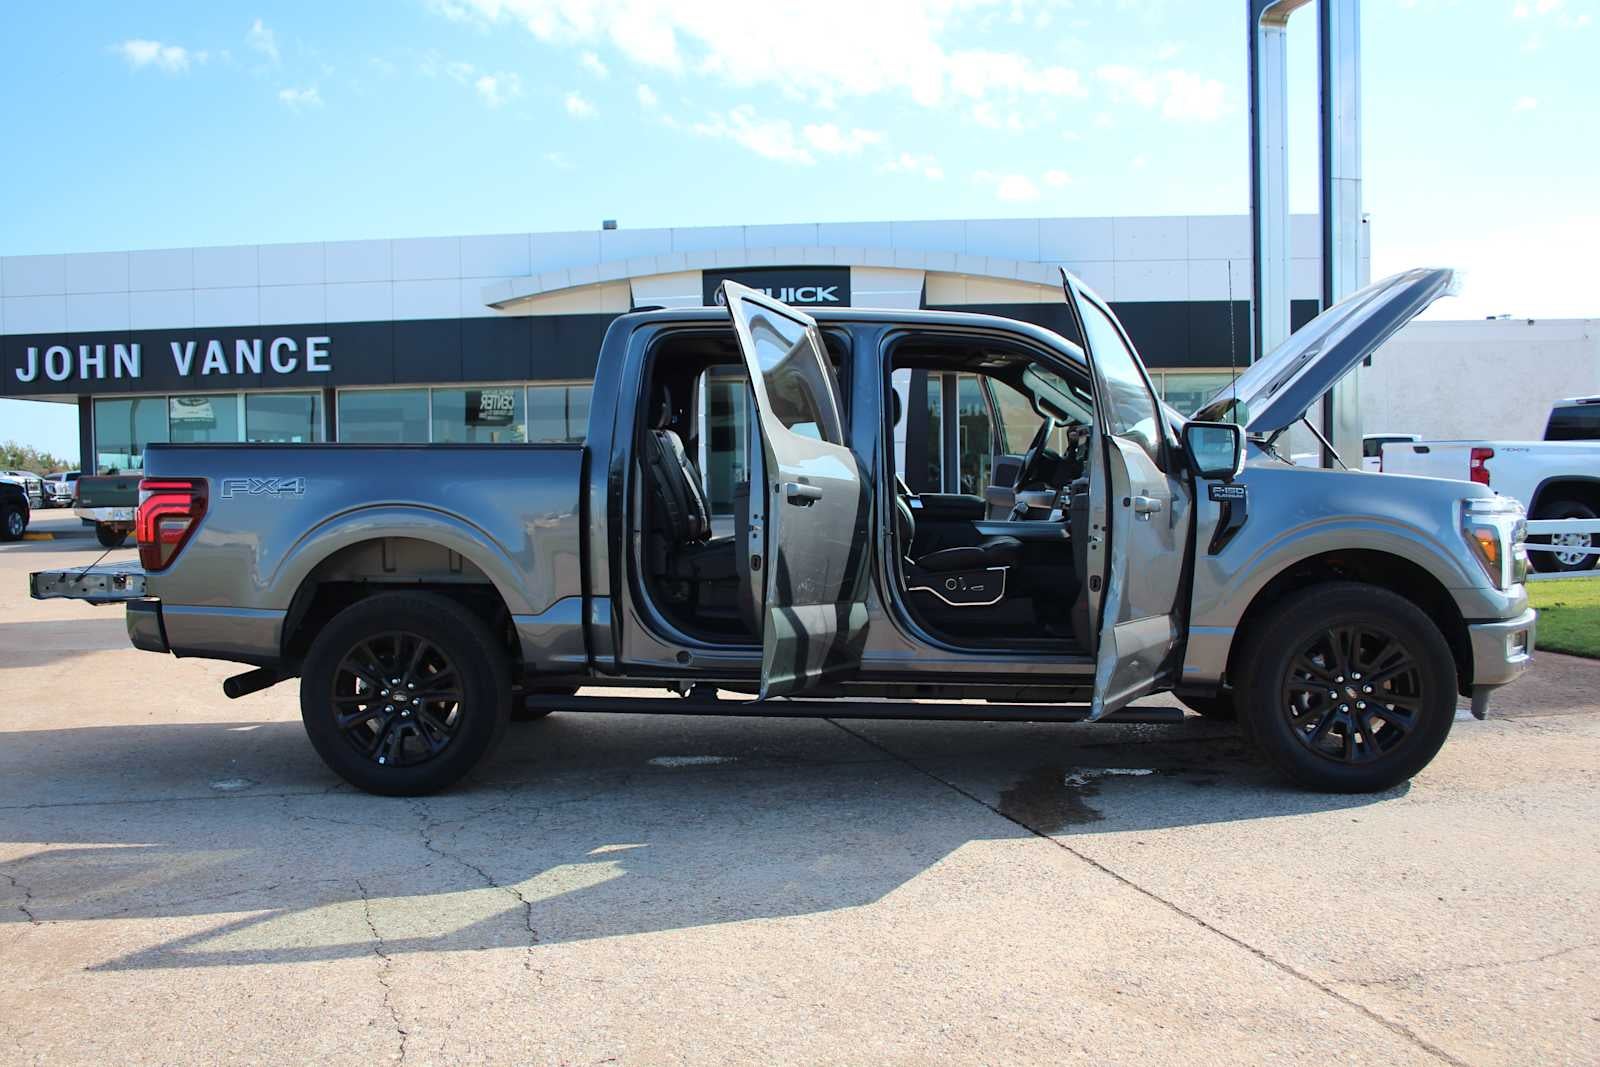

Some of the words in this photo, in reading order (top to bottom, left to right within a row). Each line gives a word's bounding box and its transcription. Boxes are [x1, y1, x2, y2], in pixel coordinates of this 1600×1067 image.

[758, 286, 839, 303] UICK
[15, 343, 142, 382] JOHN
[170, 336, 332, 376] VANCE
[221, 478, 305, 499] FX4
